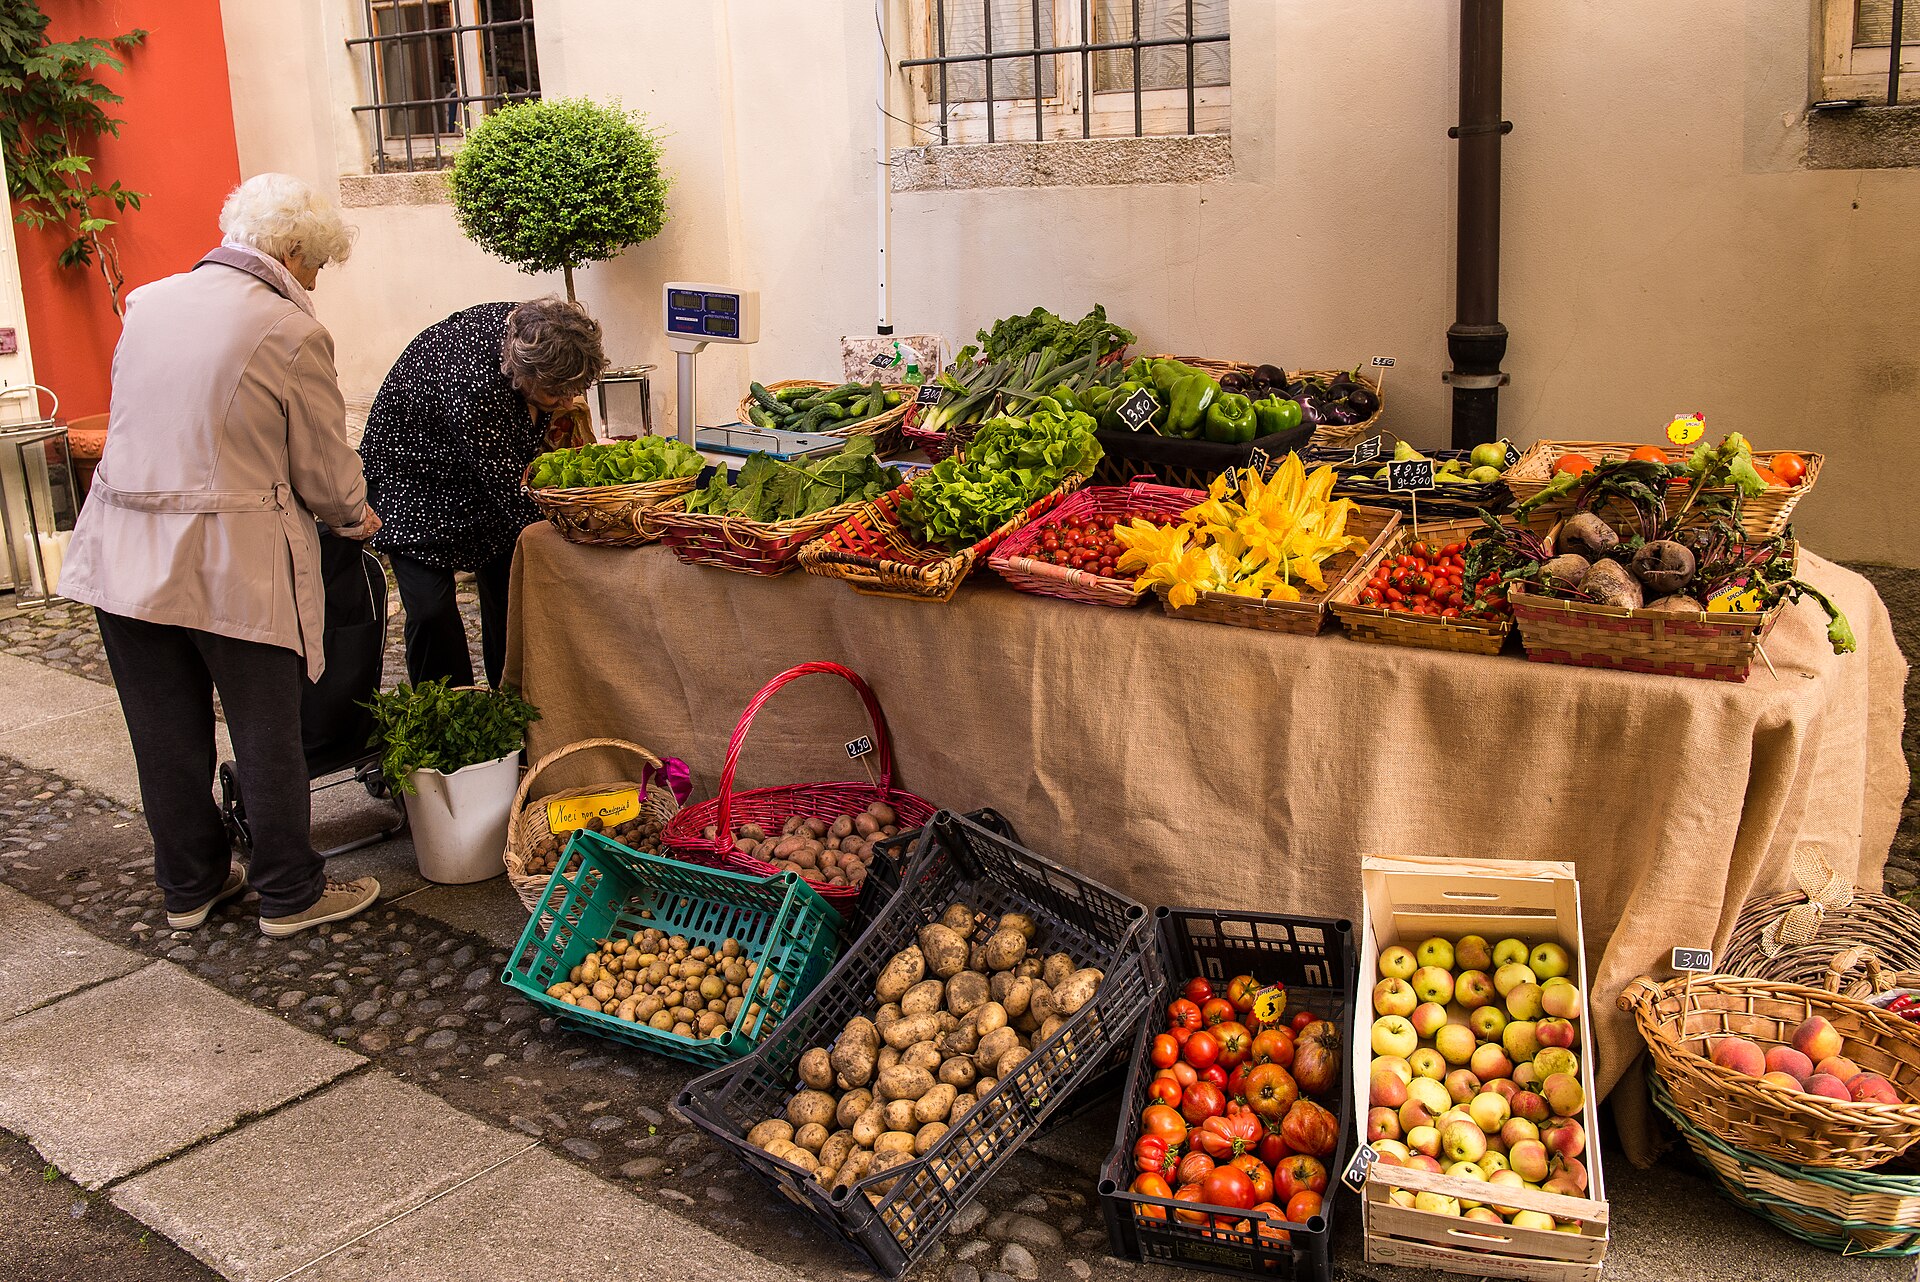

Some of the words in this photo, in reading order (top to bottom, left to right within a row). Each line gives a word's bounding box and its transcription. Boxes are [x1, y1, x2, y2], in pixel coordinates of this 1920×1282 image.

[1126, 399, 1150, 422] 3,50
[1681, 429, 1689, 440] 3
[1708, 585, 1733, 600] OFFERTA
[848, 739, 869, 755] 2.50
[1680, 952, 1709, 969] 3,00
[1349, 1149, 1372, 1183] 2,20
[1411, 1248, 1528, 1268] RONCAGLIA
